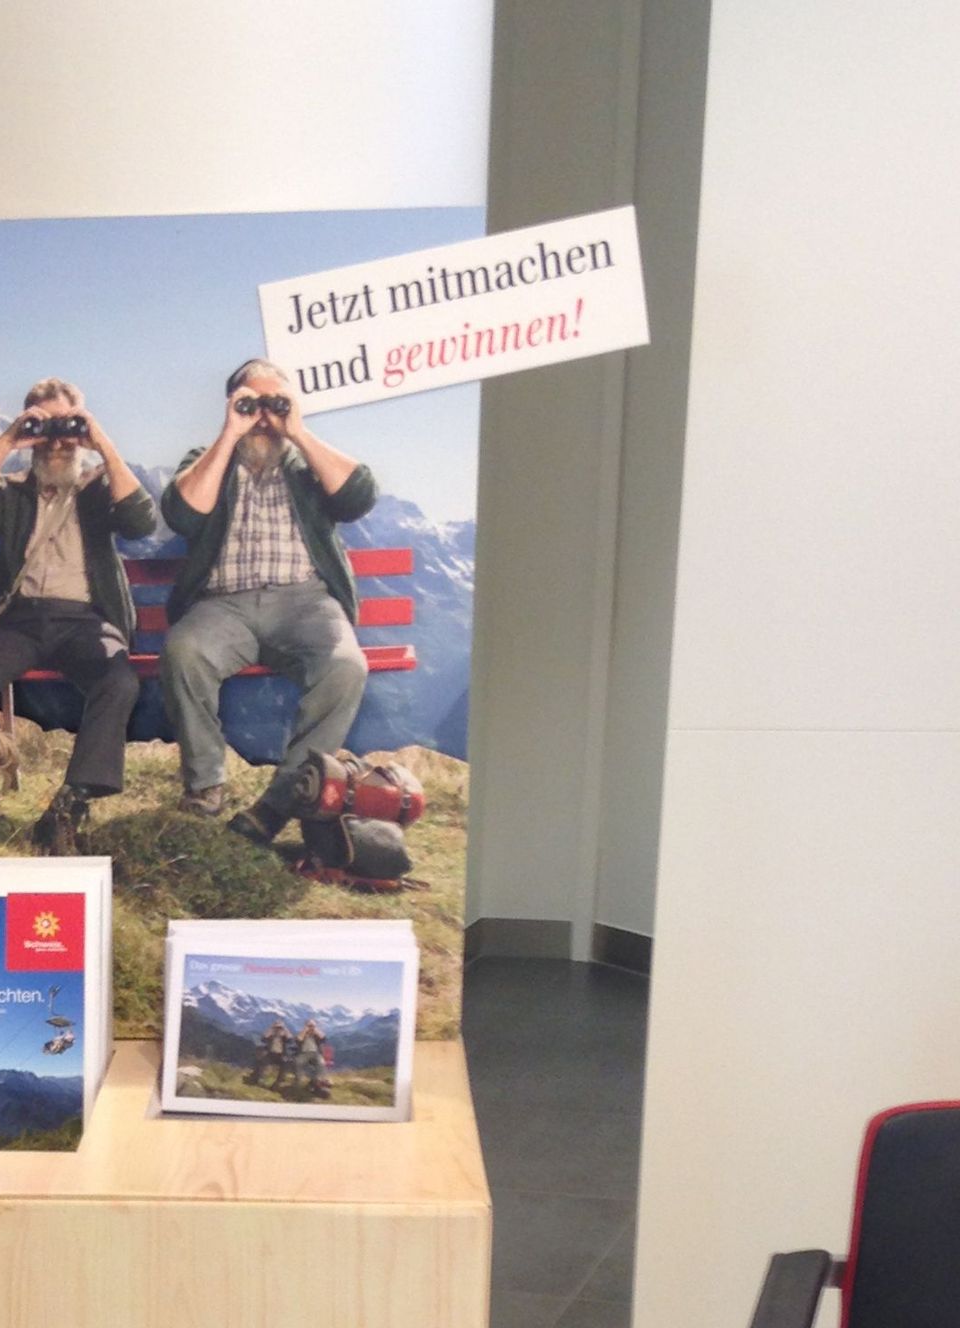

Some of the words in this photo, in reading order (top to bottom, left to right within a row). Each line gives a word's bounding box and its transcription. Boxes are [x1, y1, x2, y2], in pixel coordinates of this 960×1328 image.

[288, 284, 376, 334] Jetzt
[388, 239, 615, 313] mitmachen
[297, 344, 372, 394] und
[383, 298, 585, 388] gewinnen!
